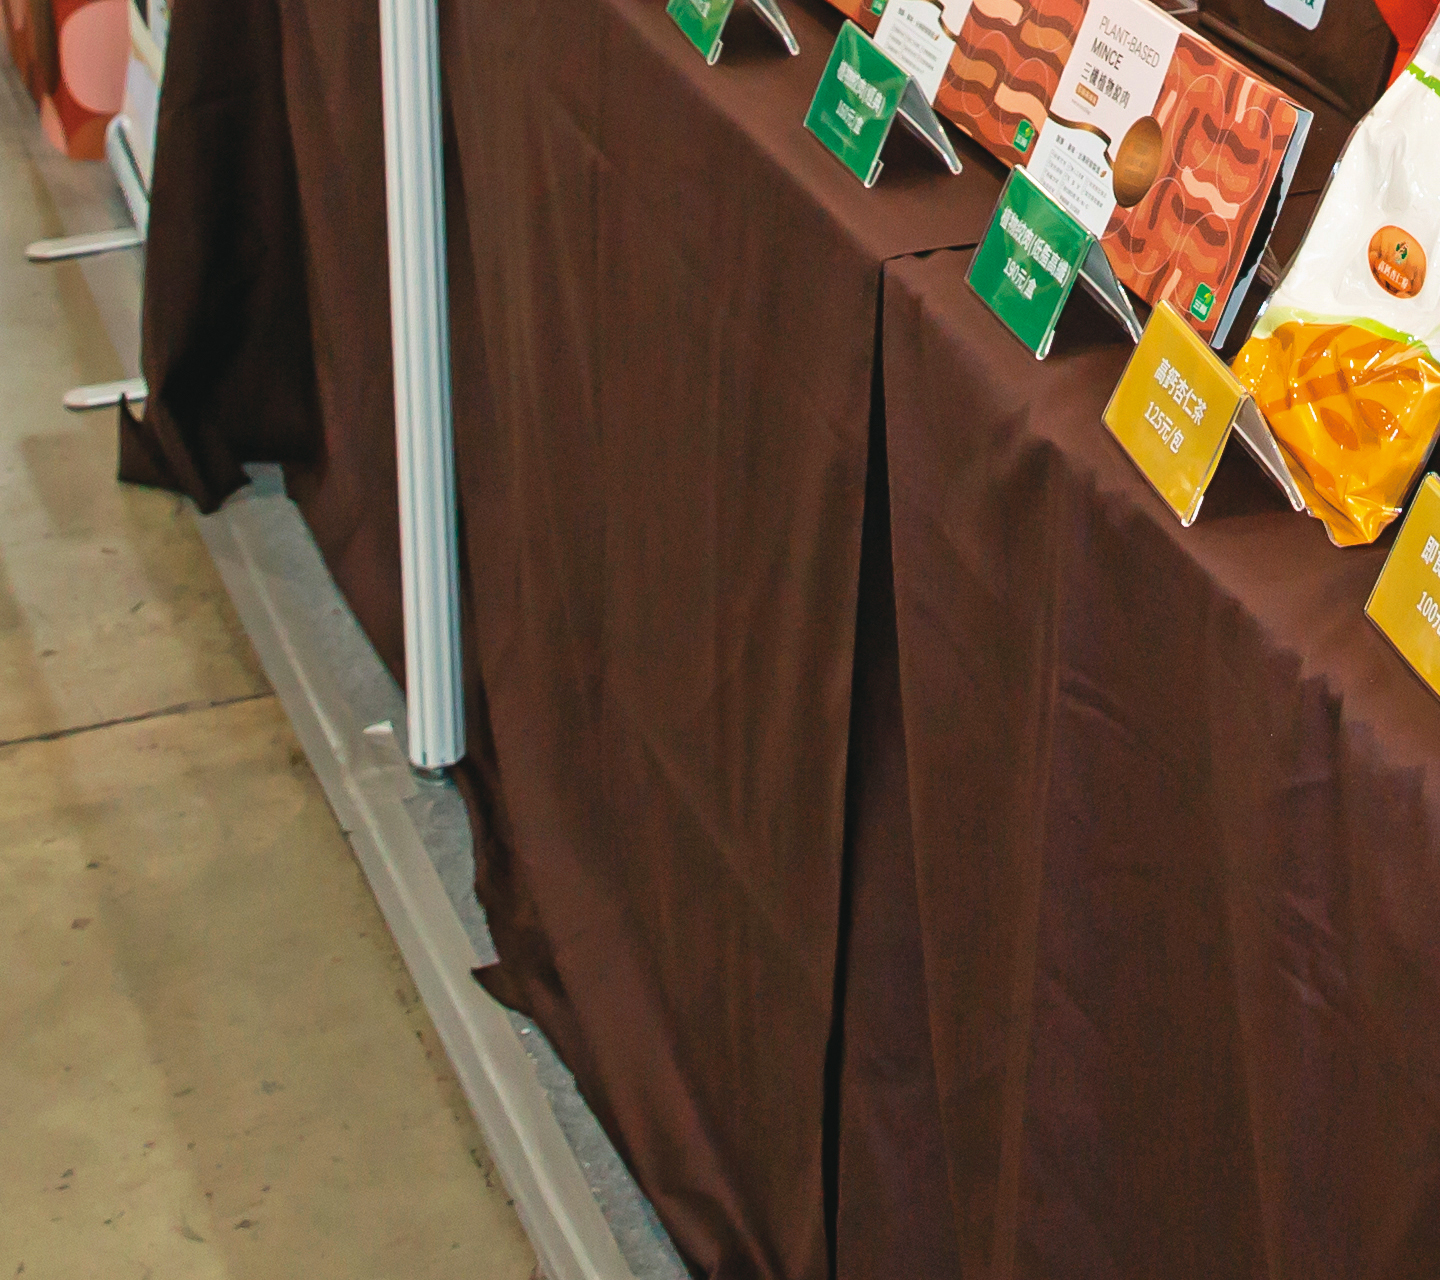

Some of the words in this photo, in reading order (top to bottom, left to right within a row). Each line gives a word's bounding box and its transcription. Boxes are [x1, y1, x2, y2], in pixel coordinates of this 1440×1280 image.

[1090, 37, 1124, 72] MINCE
[1098, 15, 1160, 70] PLANT-BASED
[1154, 357, 1208, 425] 高鈣杏仁茶
[1144, 401, 1185, 454] 125元/包
